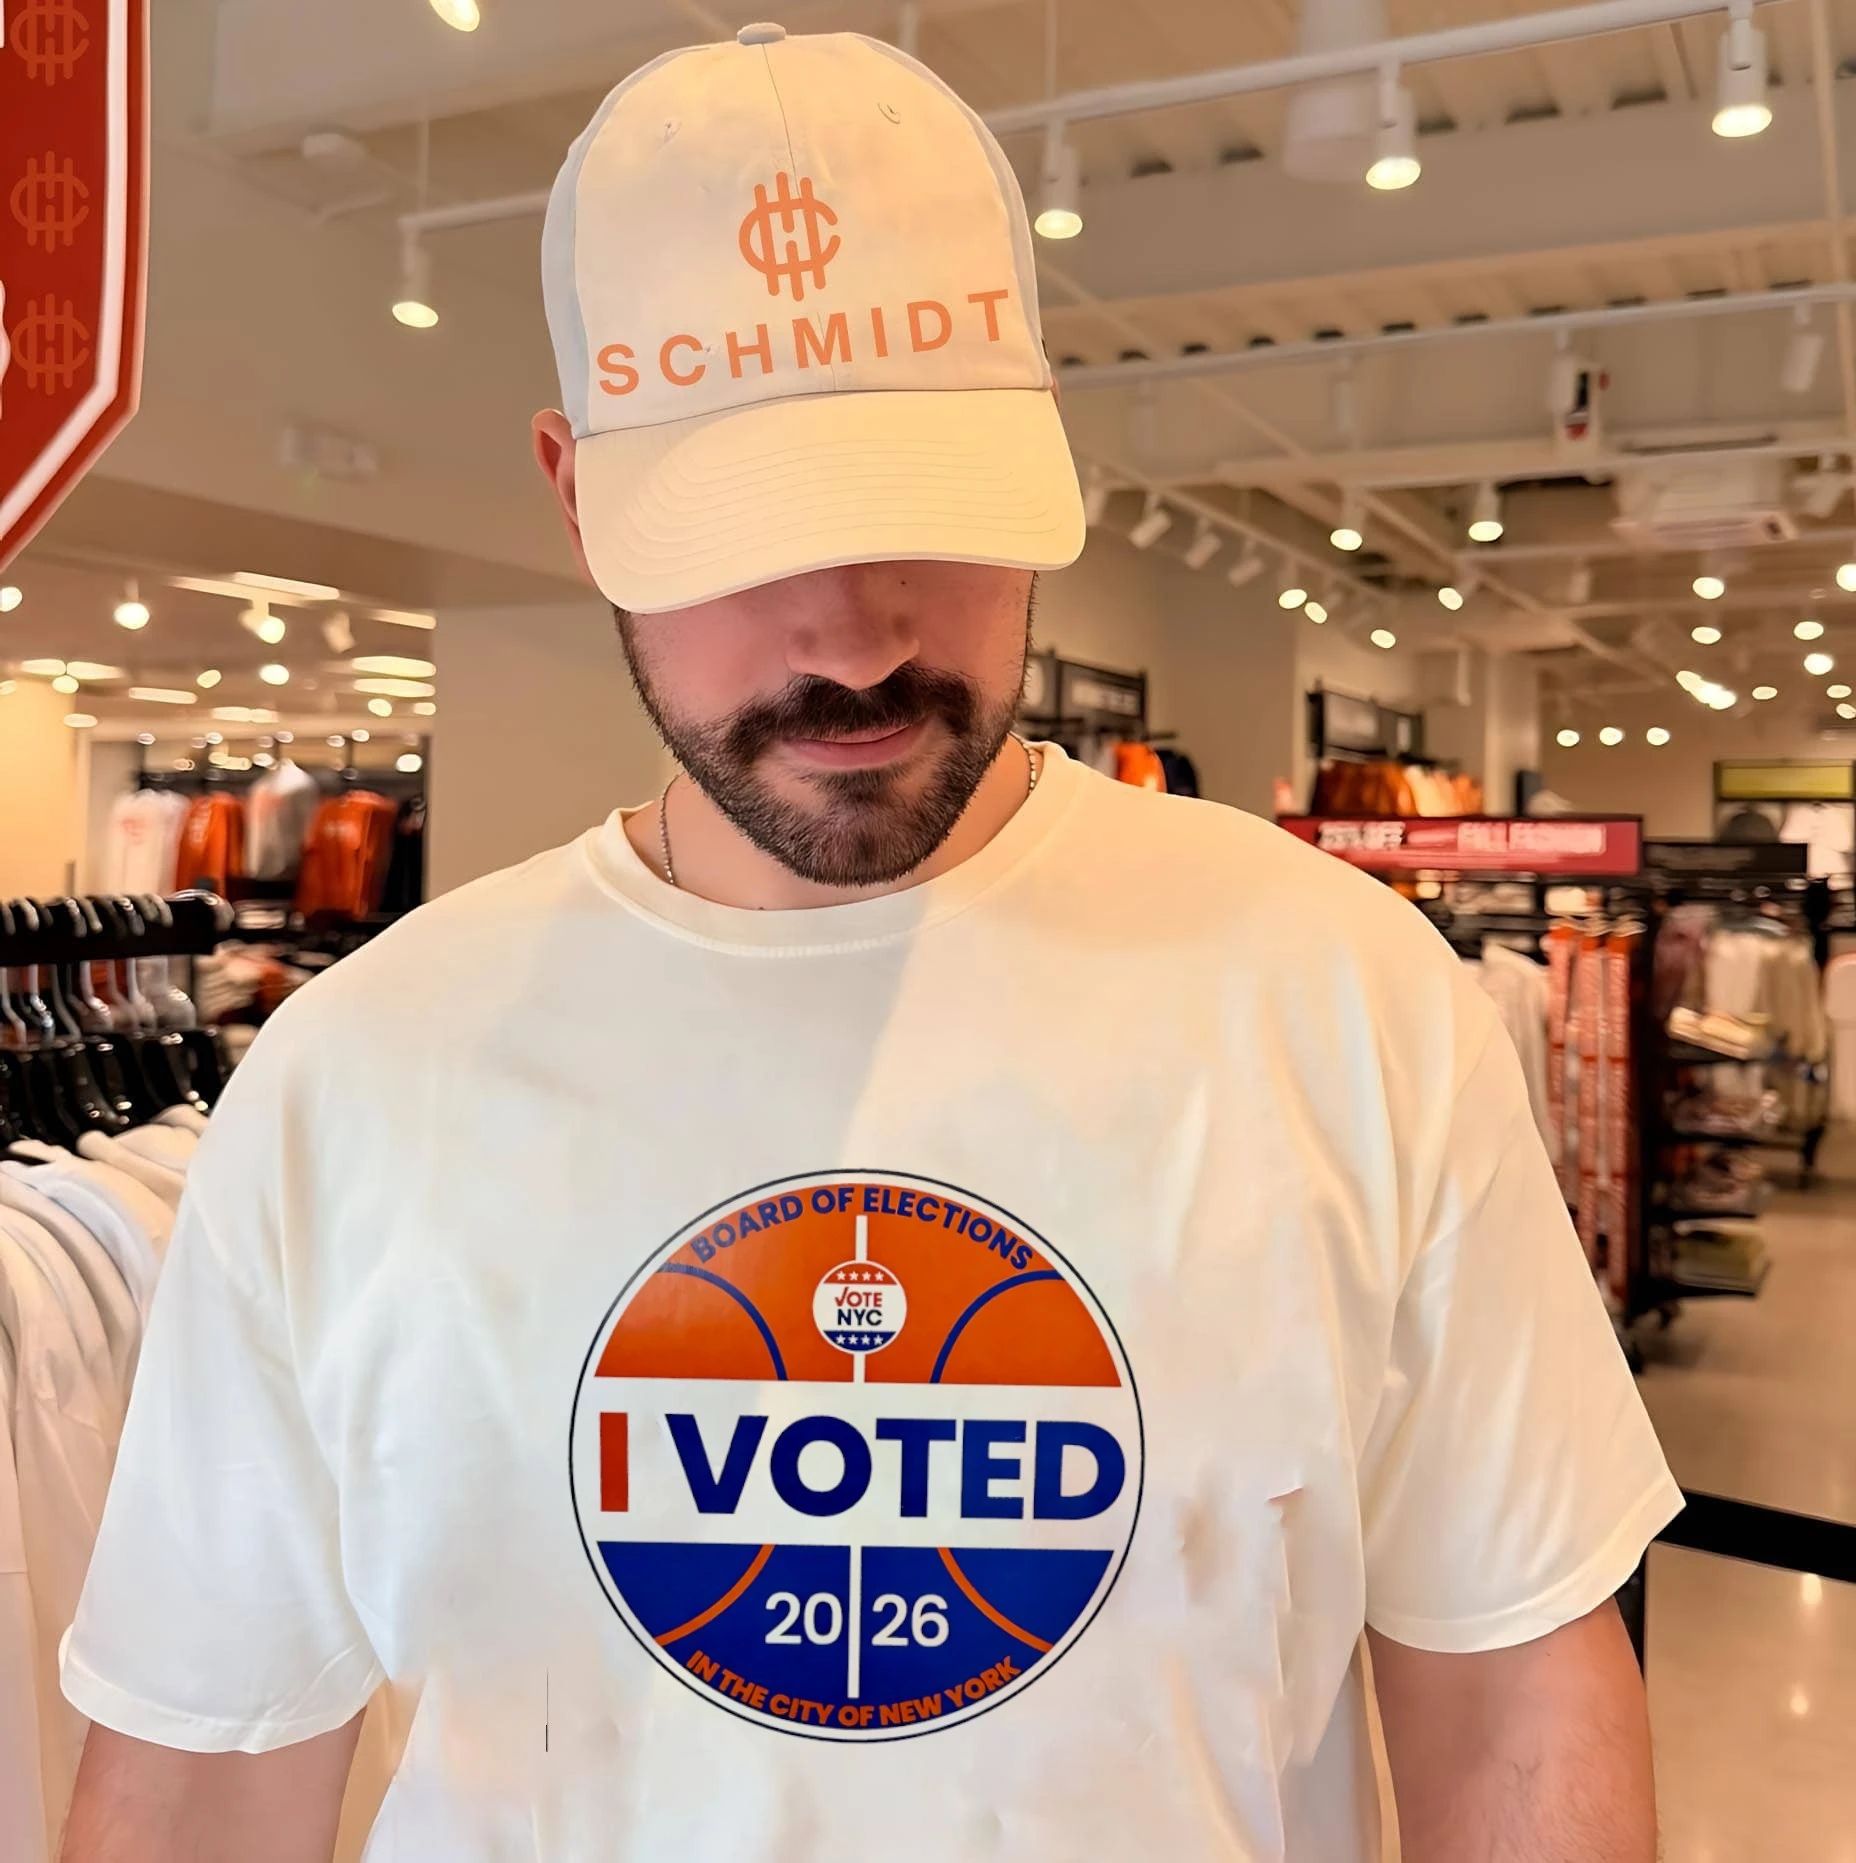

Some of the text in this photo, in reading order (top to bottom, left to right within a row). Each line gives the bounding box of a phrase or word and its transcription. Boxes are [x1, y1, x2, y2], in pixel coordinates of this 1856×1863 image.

[596, 288, 1009, 396] SCHMIDT
[689, 1187, 1034, 1271] BOARD OF ELECTIONS
[834, 1286, 883, 1308] VOTE
[837, 1308, 882, 1326] NYC
[600, 1412, 1126, 1521] I VOTED
[765, 1591, 949, 1647] 20 26
[686, 1650, 1021, 1727] IN THE CITY OF NEW YORK
